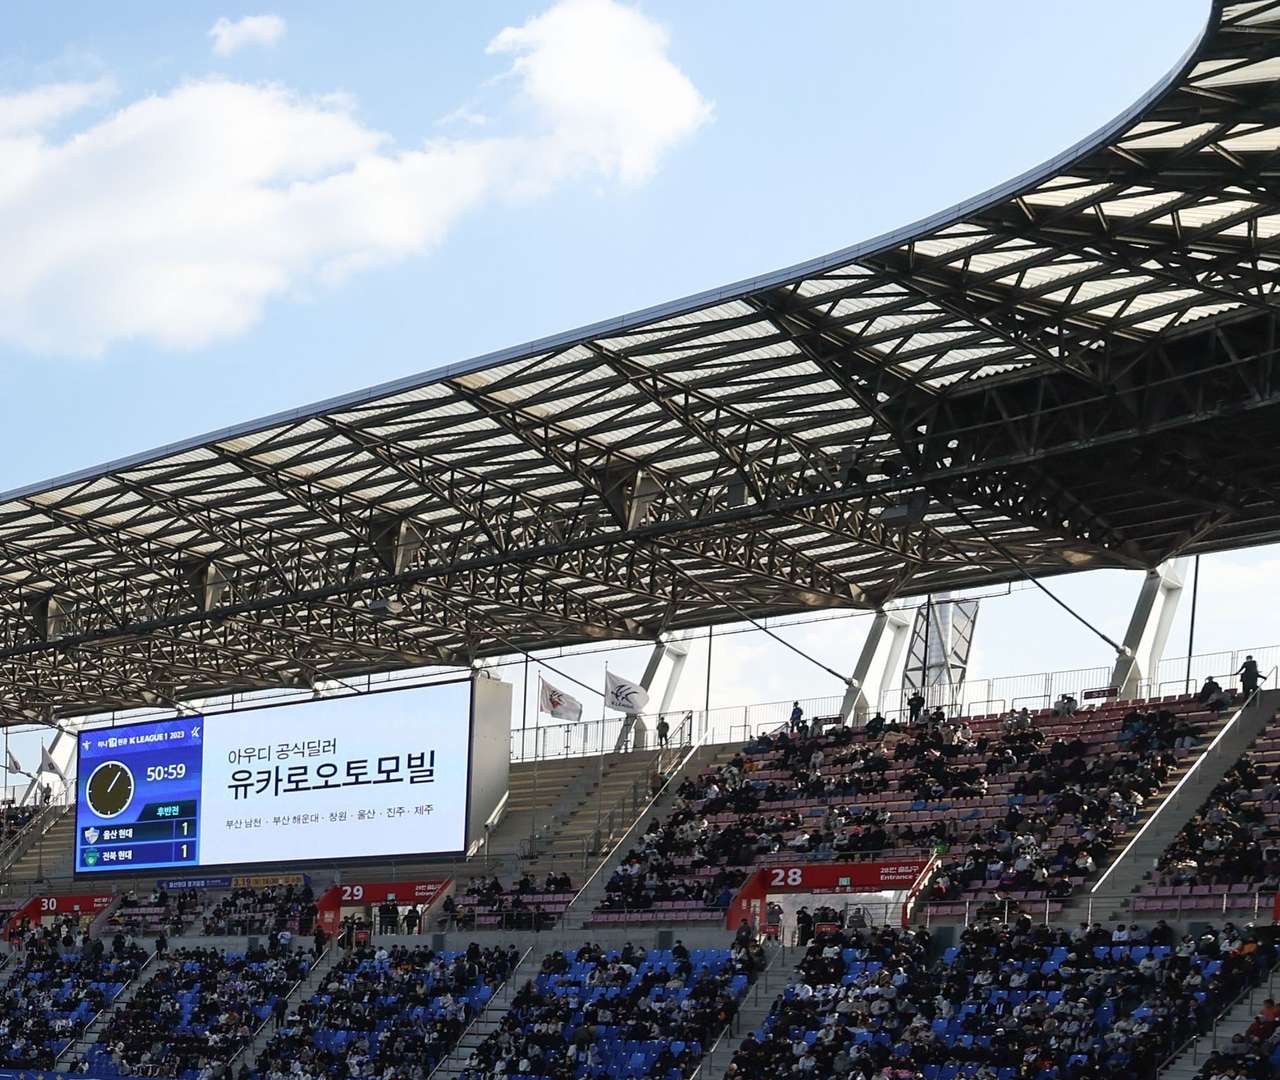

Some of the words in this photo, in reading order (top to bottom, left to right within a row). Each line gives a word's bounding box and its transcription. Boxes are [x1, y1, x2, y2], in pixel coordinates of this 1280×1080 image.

[137, 734, 164, 743] LEAGUE
[170, 731, 185, 740] 2023
[228, 745, 272, 764] 아우디
[276, 738, 337, 760] 공식딜러
[146, 763, 186, 782] 50:59
[228, 750, 436, 800] 유카로오토모빌
[156, 805, 180, 816] 후반전
[292, 813, 319, 824] 해운대
[414, 803, 434, 816] 제주
[182, 821, 189, 836] 1
[181, 844, 188, 858] 1
[770, 868, 803, 886] 28
[342, 885, 363, 900] 29
[40, 897, 57, 911] 30
